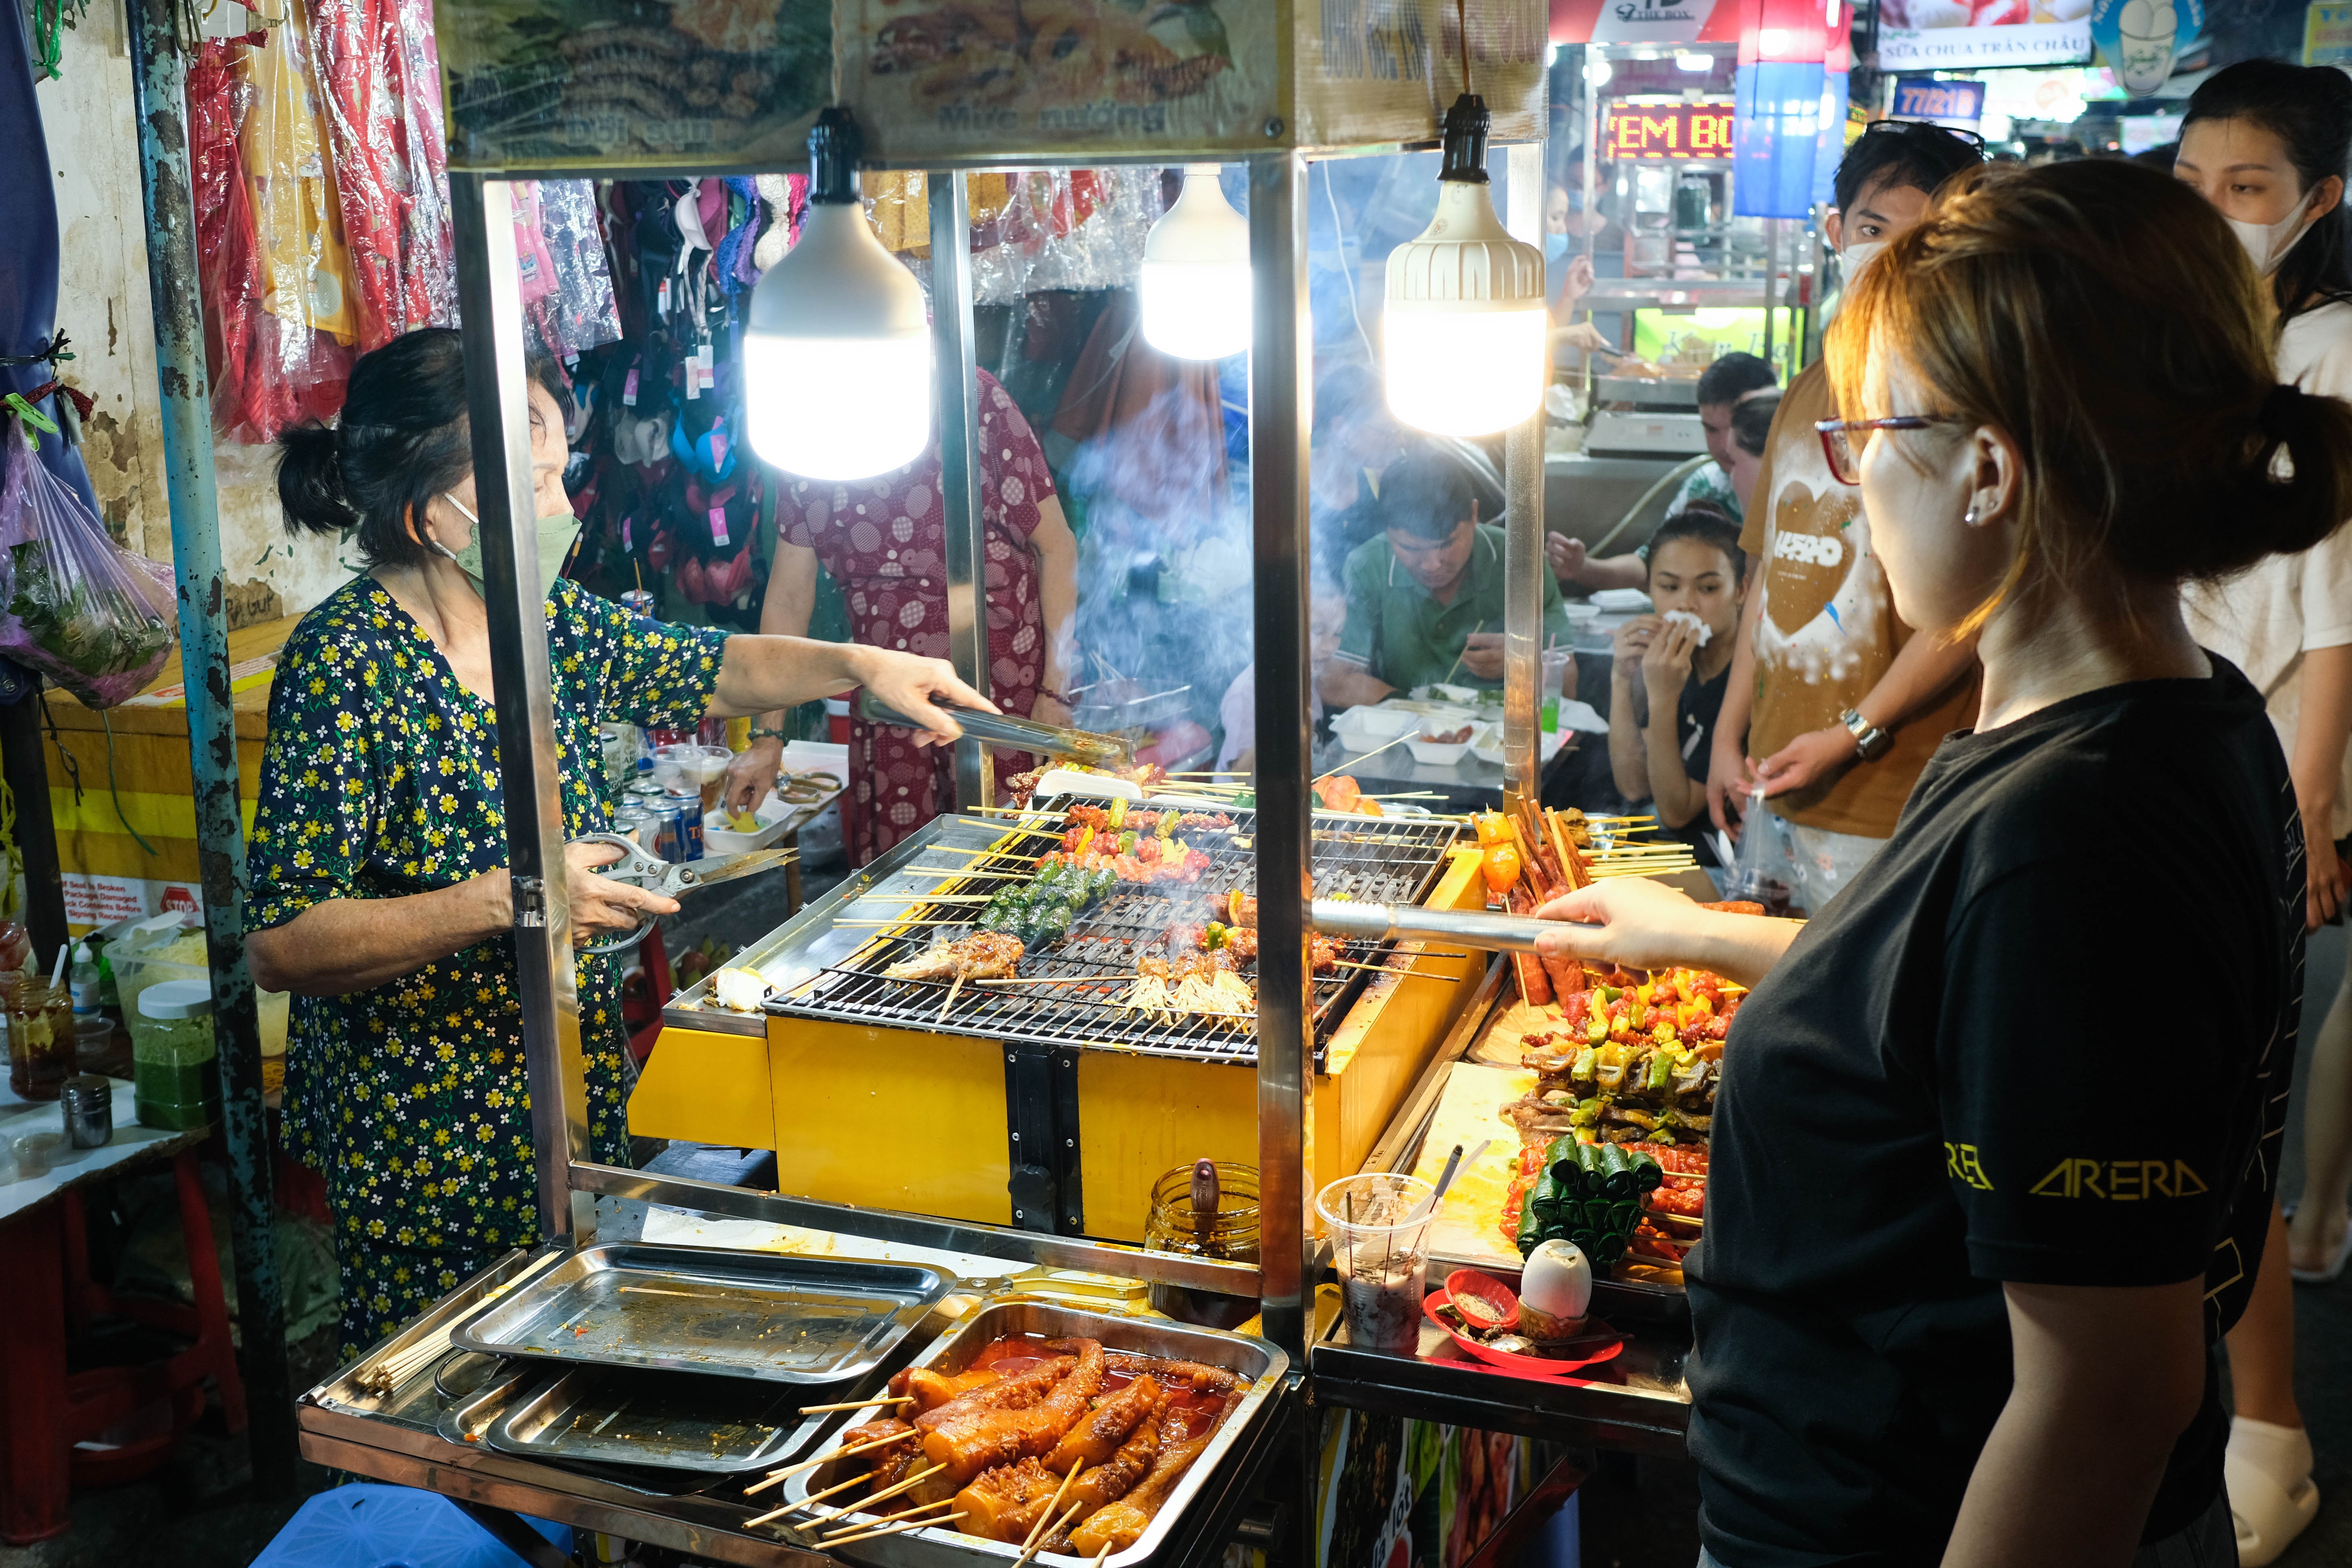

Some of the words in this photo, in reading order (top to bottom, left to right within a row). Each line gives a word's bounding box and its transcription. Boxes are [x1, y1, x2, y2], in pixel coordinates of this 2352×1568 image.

[1901, 86, 1974, 117] 77/21B
[69, 881, 86, 889] Seal
[97, 883, 126, 892] Broken
[64, 890, 98, 901] Package
[100, 893, 137, 903] Damaged
[79, 901, 114, 910] Contents
[116, 903, 142, 913] Before
[166, 899, 193, 913] STOP
[68, 909, 97, 920] Signing
[98, 912, 128, 921] Receipt
